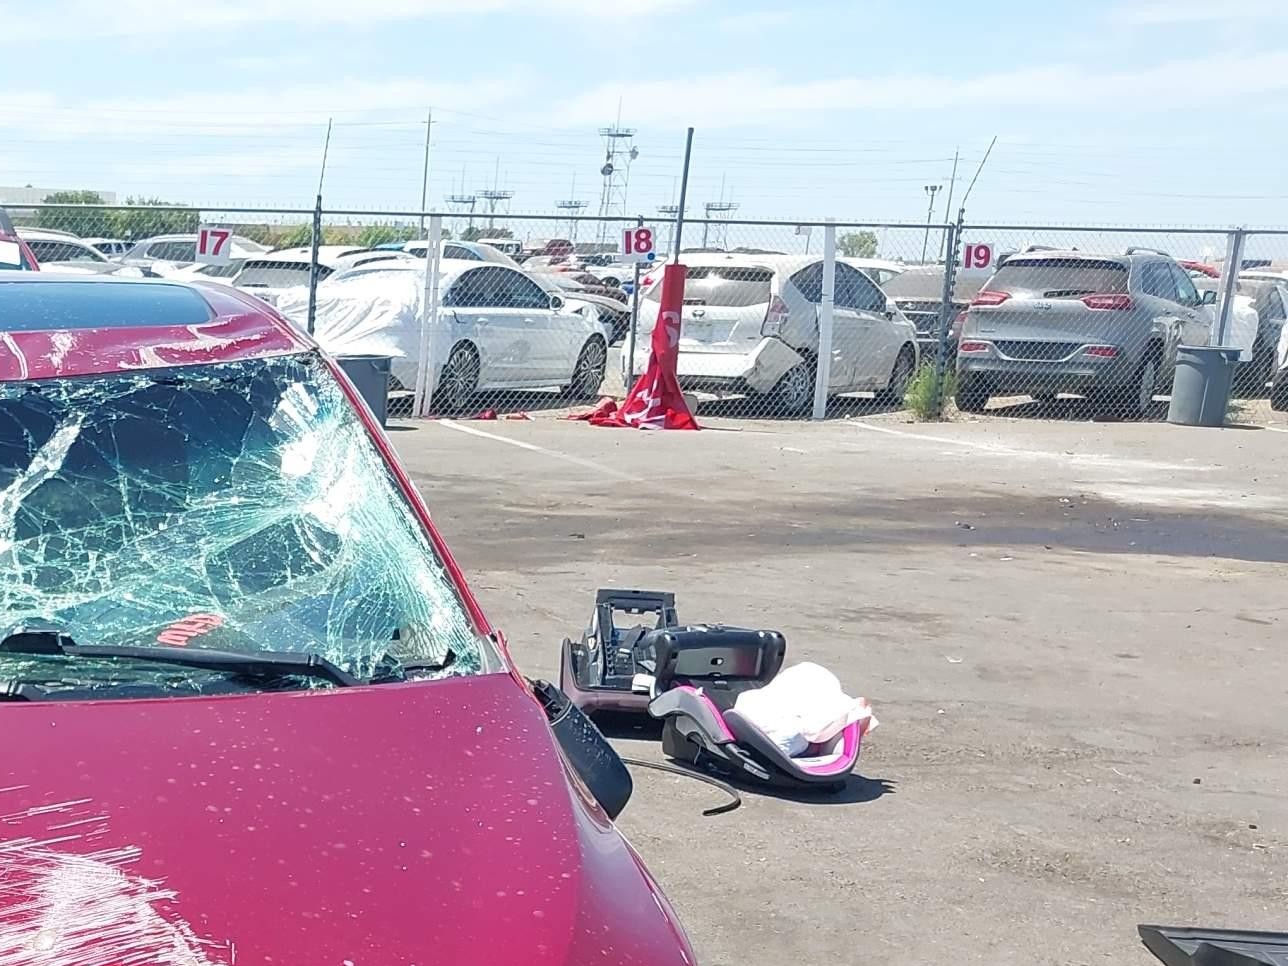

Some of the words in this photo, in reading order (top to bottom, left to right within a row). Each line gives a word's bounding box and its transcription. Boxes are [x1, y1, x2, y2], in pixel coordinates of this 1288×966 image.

[199, 230, 229, 256] 17
[625, 229, 652, 254] 18
[965, 245, 990, 268] 19
